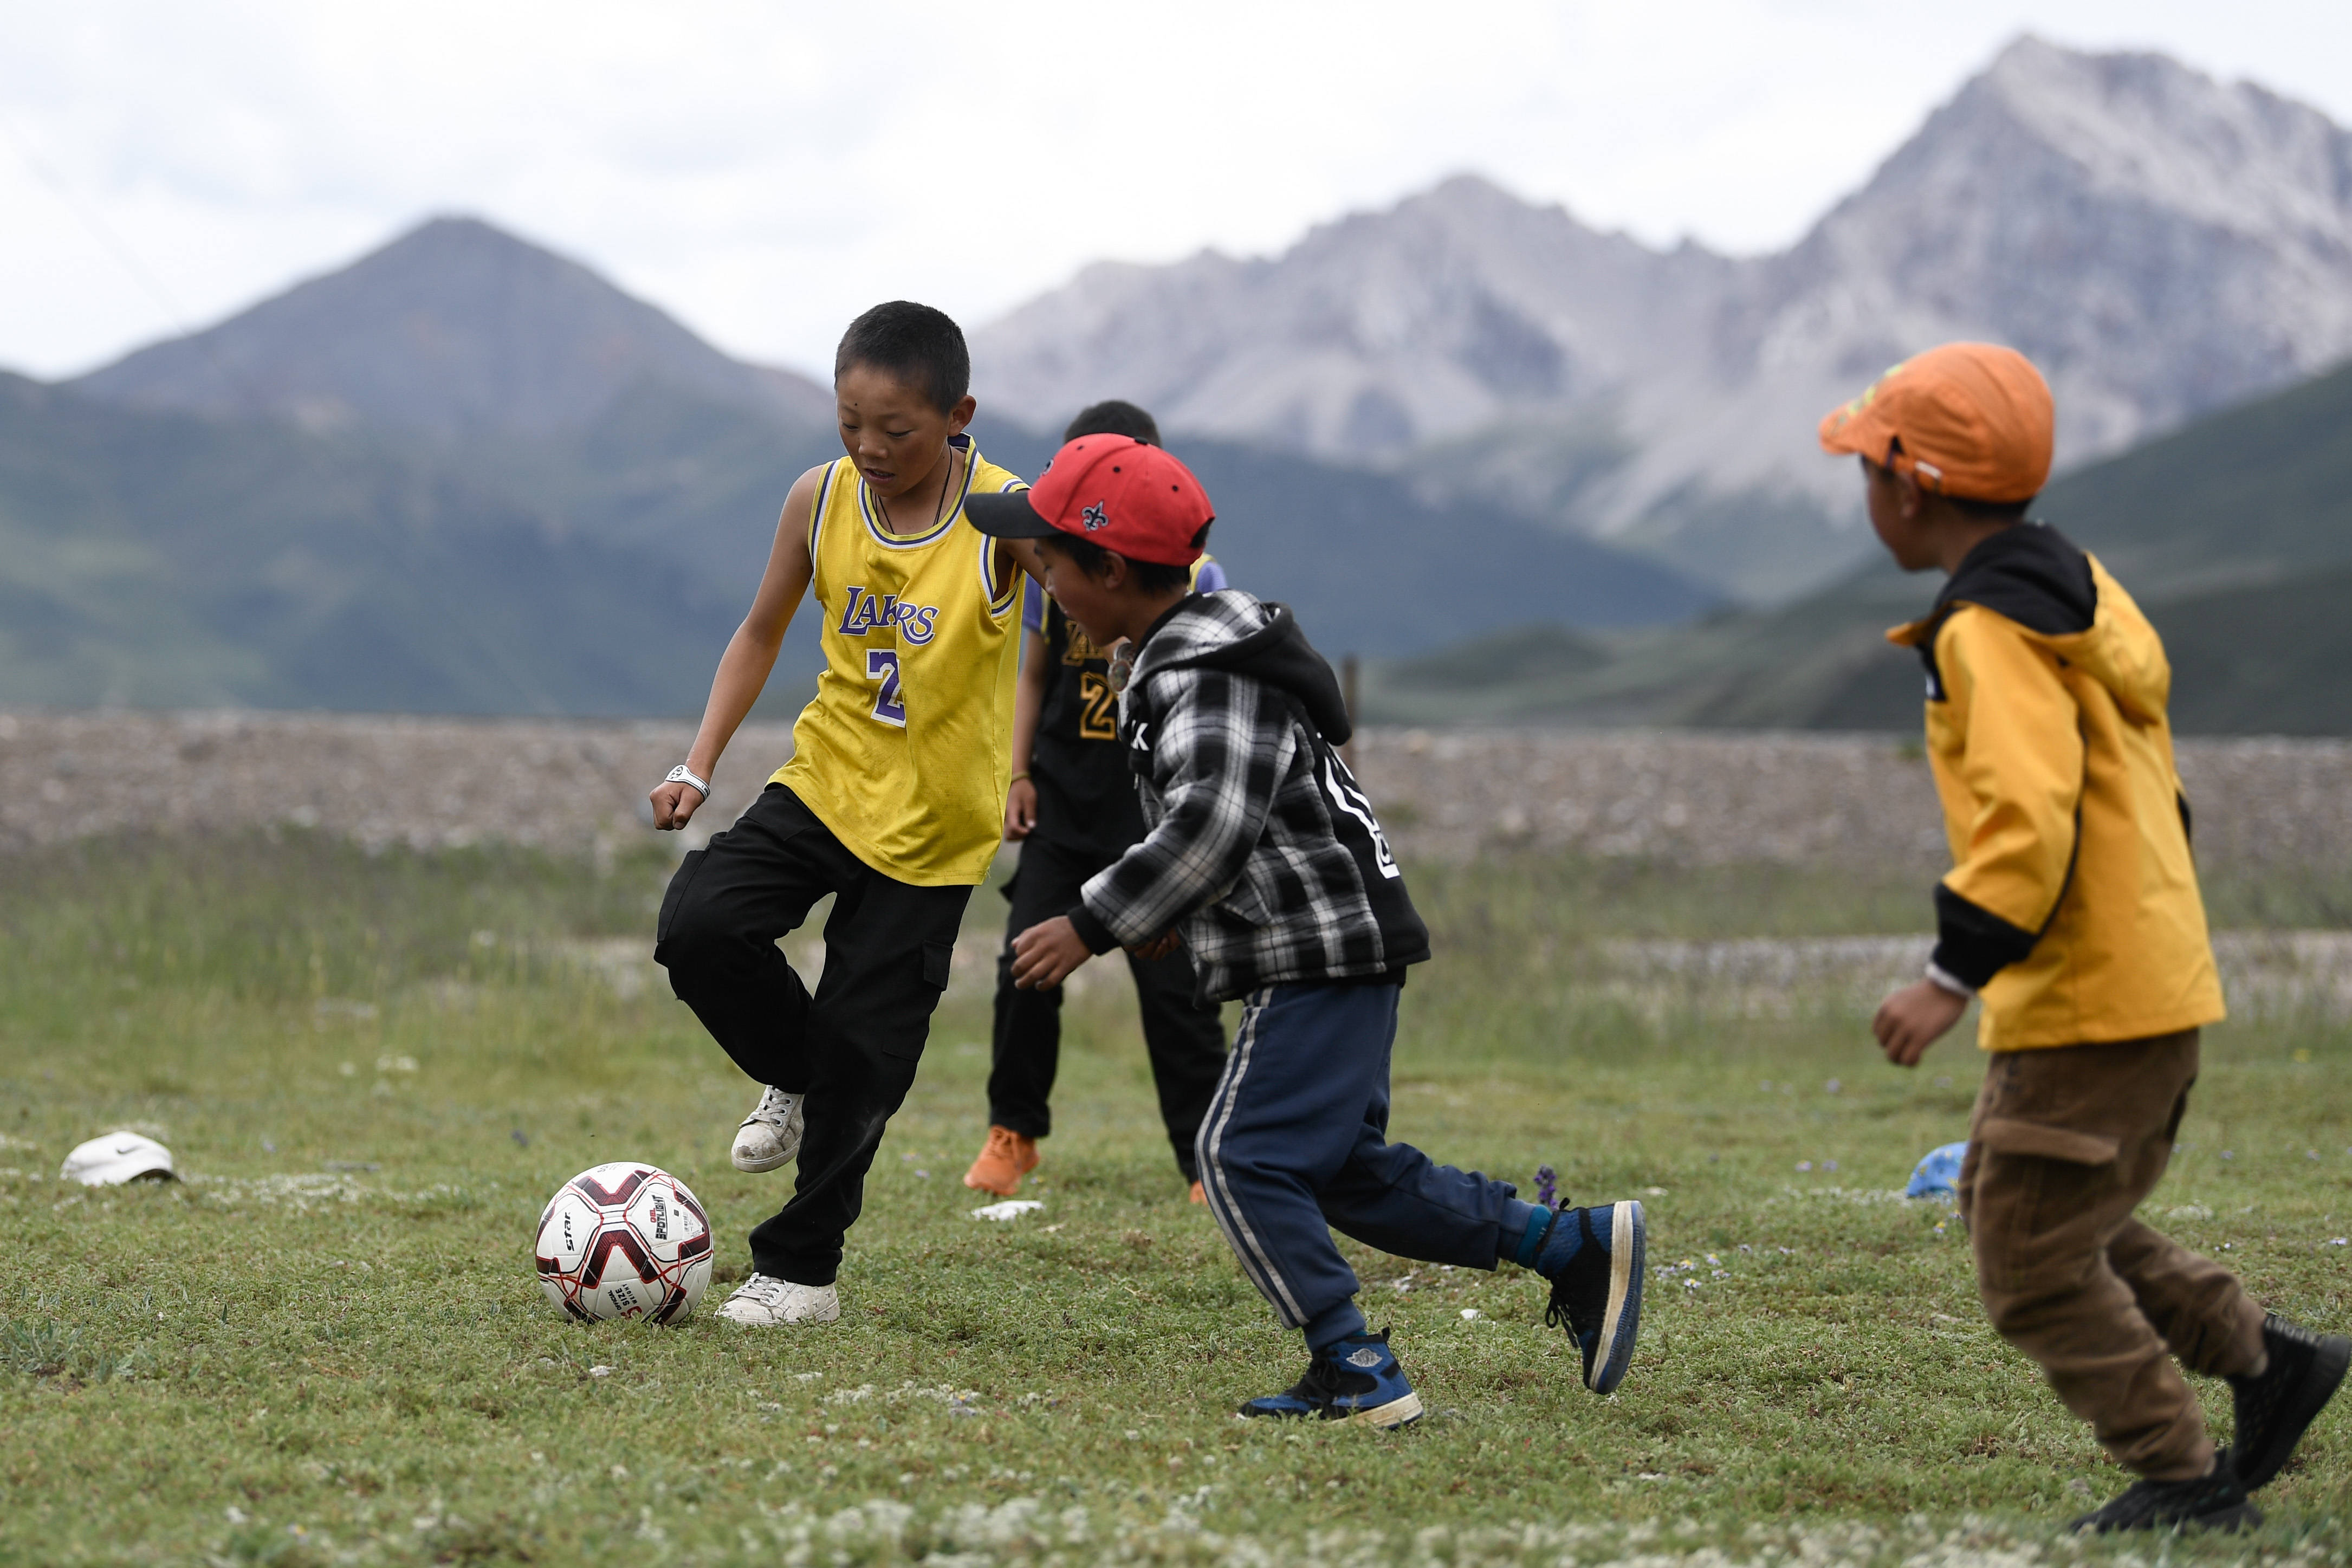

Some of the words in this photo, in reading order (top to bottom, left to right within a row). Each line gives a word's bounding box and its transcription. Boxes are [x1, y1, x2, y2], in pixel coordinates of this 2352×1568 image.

[866, 649, 906, 728] 2
[1080, 671, 1119, 740] 2
[652, 1195, 668, 1240] SPOTLIGHT
[608, 1290, 621, 1310] OFFICIAL
[615, 1288, 630, 1306] SIZE
[621, 1284, 637, 1304] WEIGHT
